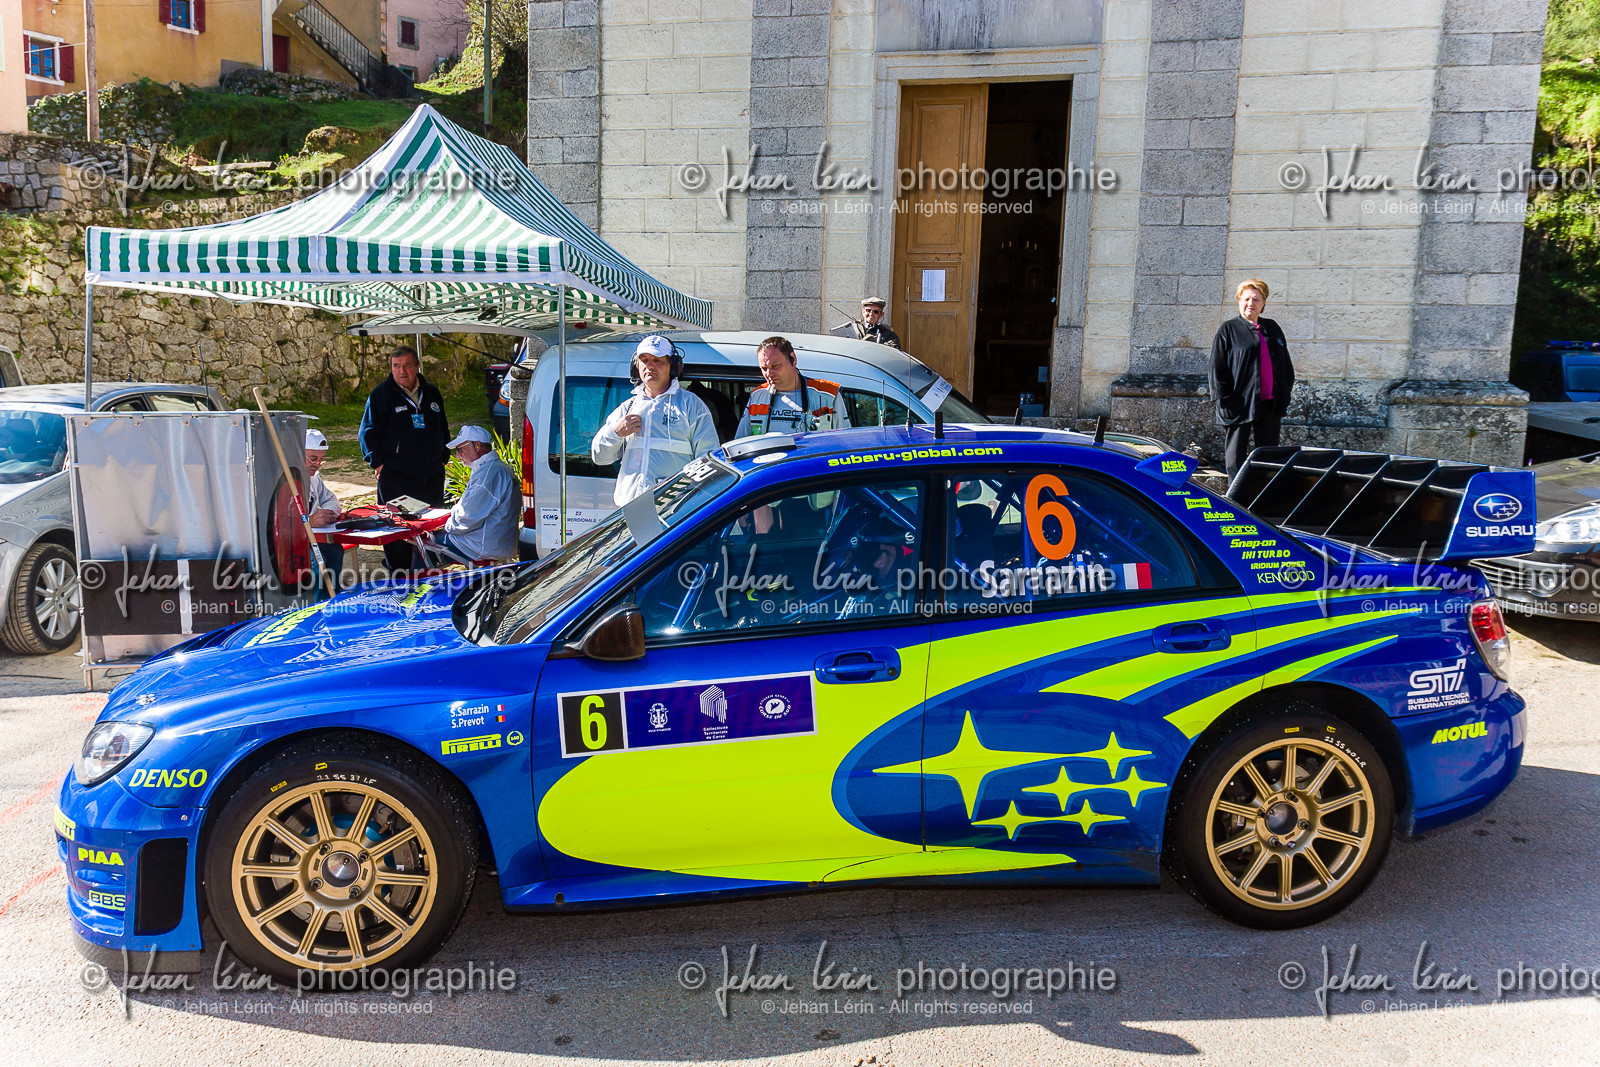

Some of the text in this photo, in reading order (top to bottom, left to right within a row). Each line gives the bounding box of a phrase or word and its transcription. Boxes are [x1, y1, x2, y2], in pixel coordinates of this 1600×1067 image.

[828, 447, 1003, 467] subaru-global.com
[1161, 460, 1187, 469] NSK
[1024, 473, 1076, 560] 6
[1466, 524, 1533, 538] SUBARU
[1230, 538, 1276, 549] Snap-on
[1241, 551, 1256, 560] IHI
[1250, 560, 1306, 570] IRIDIUM POWER
[979, 554, 1107, 598] Sarrazin
[1257, 570, 1315, 584] KENWOOD
[1407, 691, 1470, 705] SUBARU TECNICA
[1407, 698, 1470, 711] INTERNATIONAL
[450, 704, 490, 718] S.Sarrazin
[451, 716, 485, 728] S.Prevot
[579, 695, 608, 750] 6
[1431, 721, 1488, 744] MOTUL
[441, 734, 502, 755] PIRELLI
[128, 768, 208, 788] DENSO
[77, 847, 124, 866] PIAA
[88, 889, 126, 911] BBS
